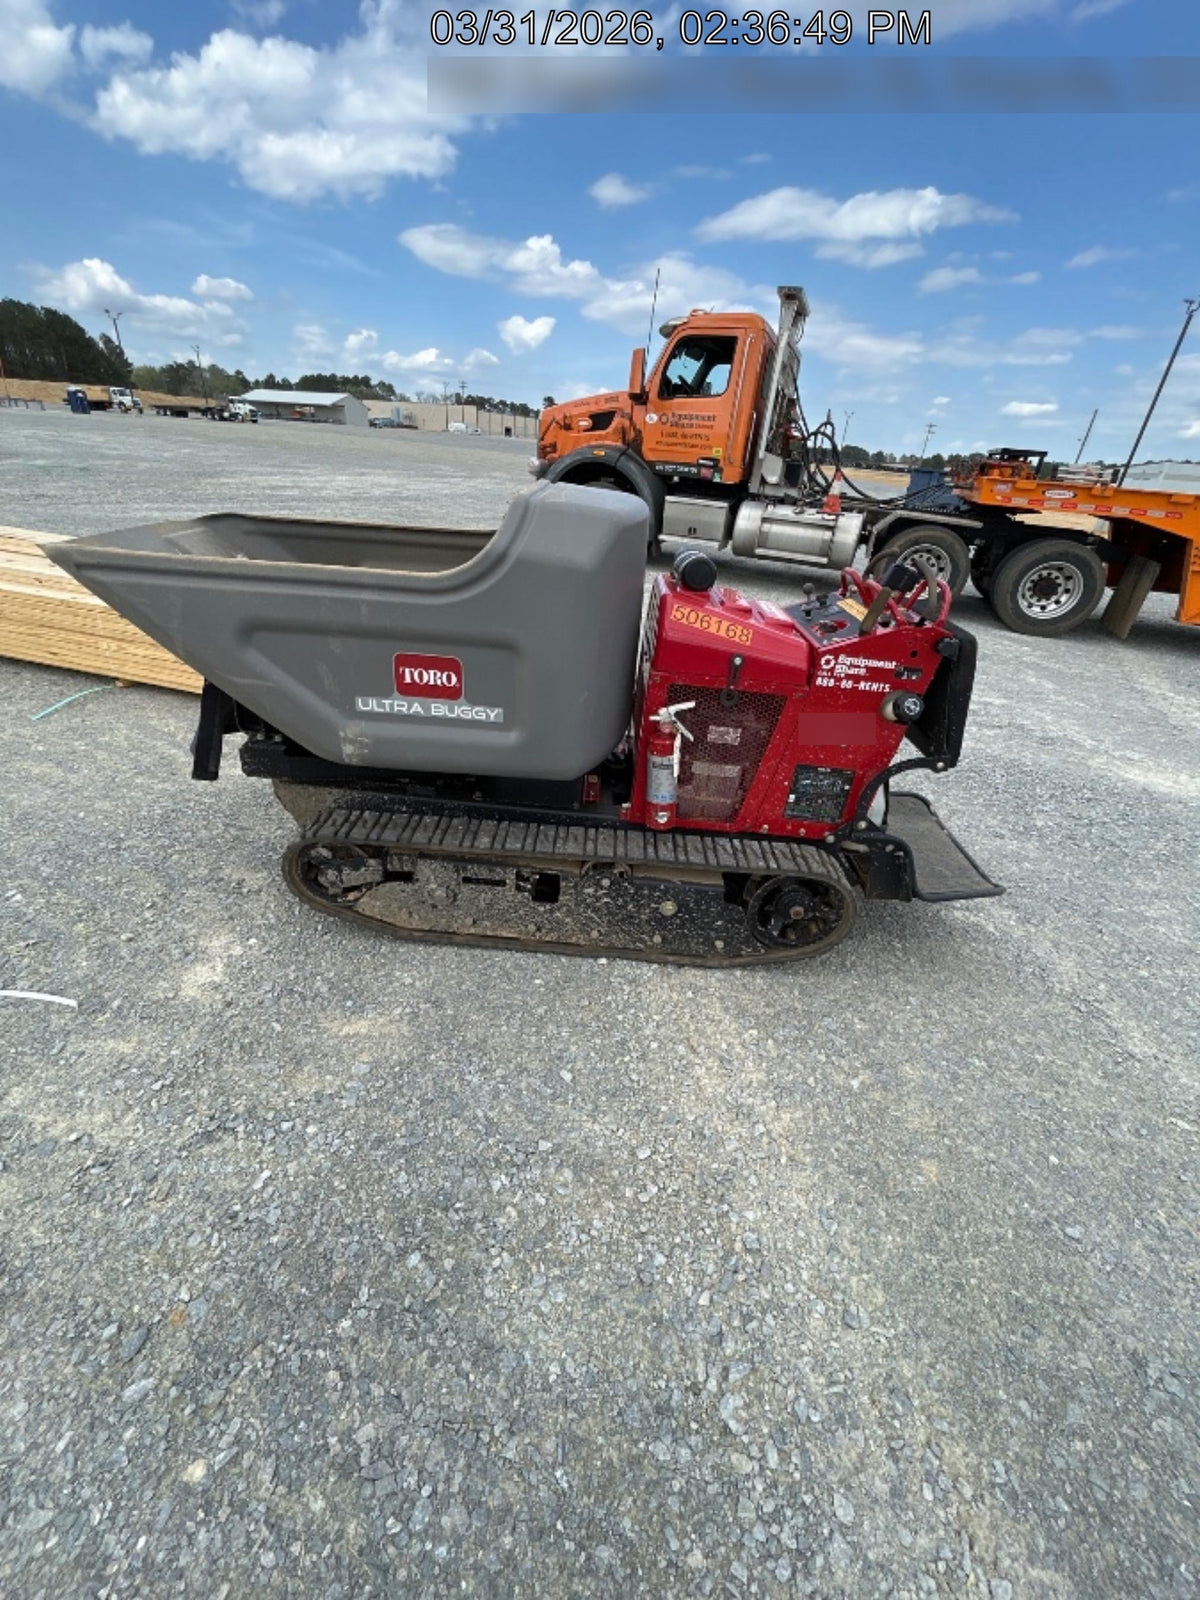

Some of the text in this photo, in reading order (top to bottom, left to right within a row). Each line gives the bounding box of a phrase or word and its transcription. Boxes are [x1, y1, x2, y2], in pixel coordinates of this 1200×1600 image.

[673, 605, 751, 643] 506168
[835, 664, 867, 675] Share
[838, 655, 897, 669] Equipment
[399, 666, 457, 687] TORO
[358, 698, 499, 722] ULTRA BUGGY
